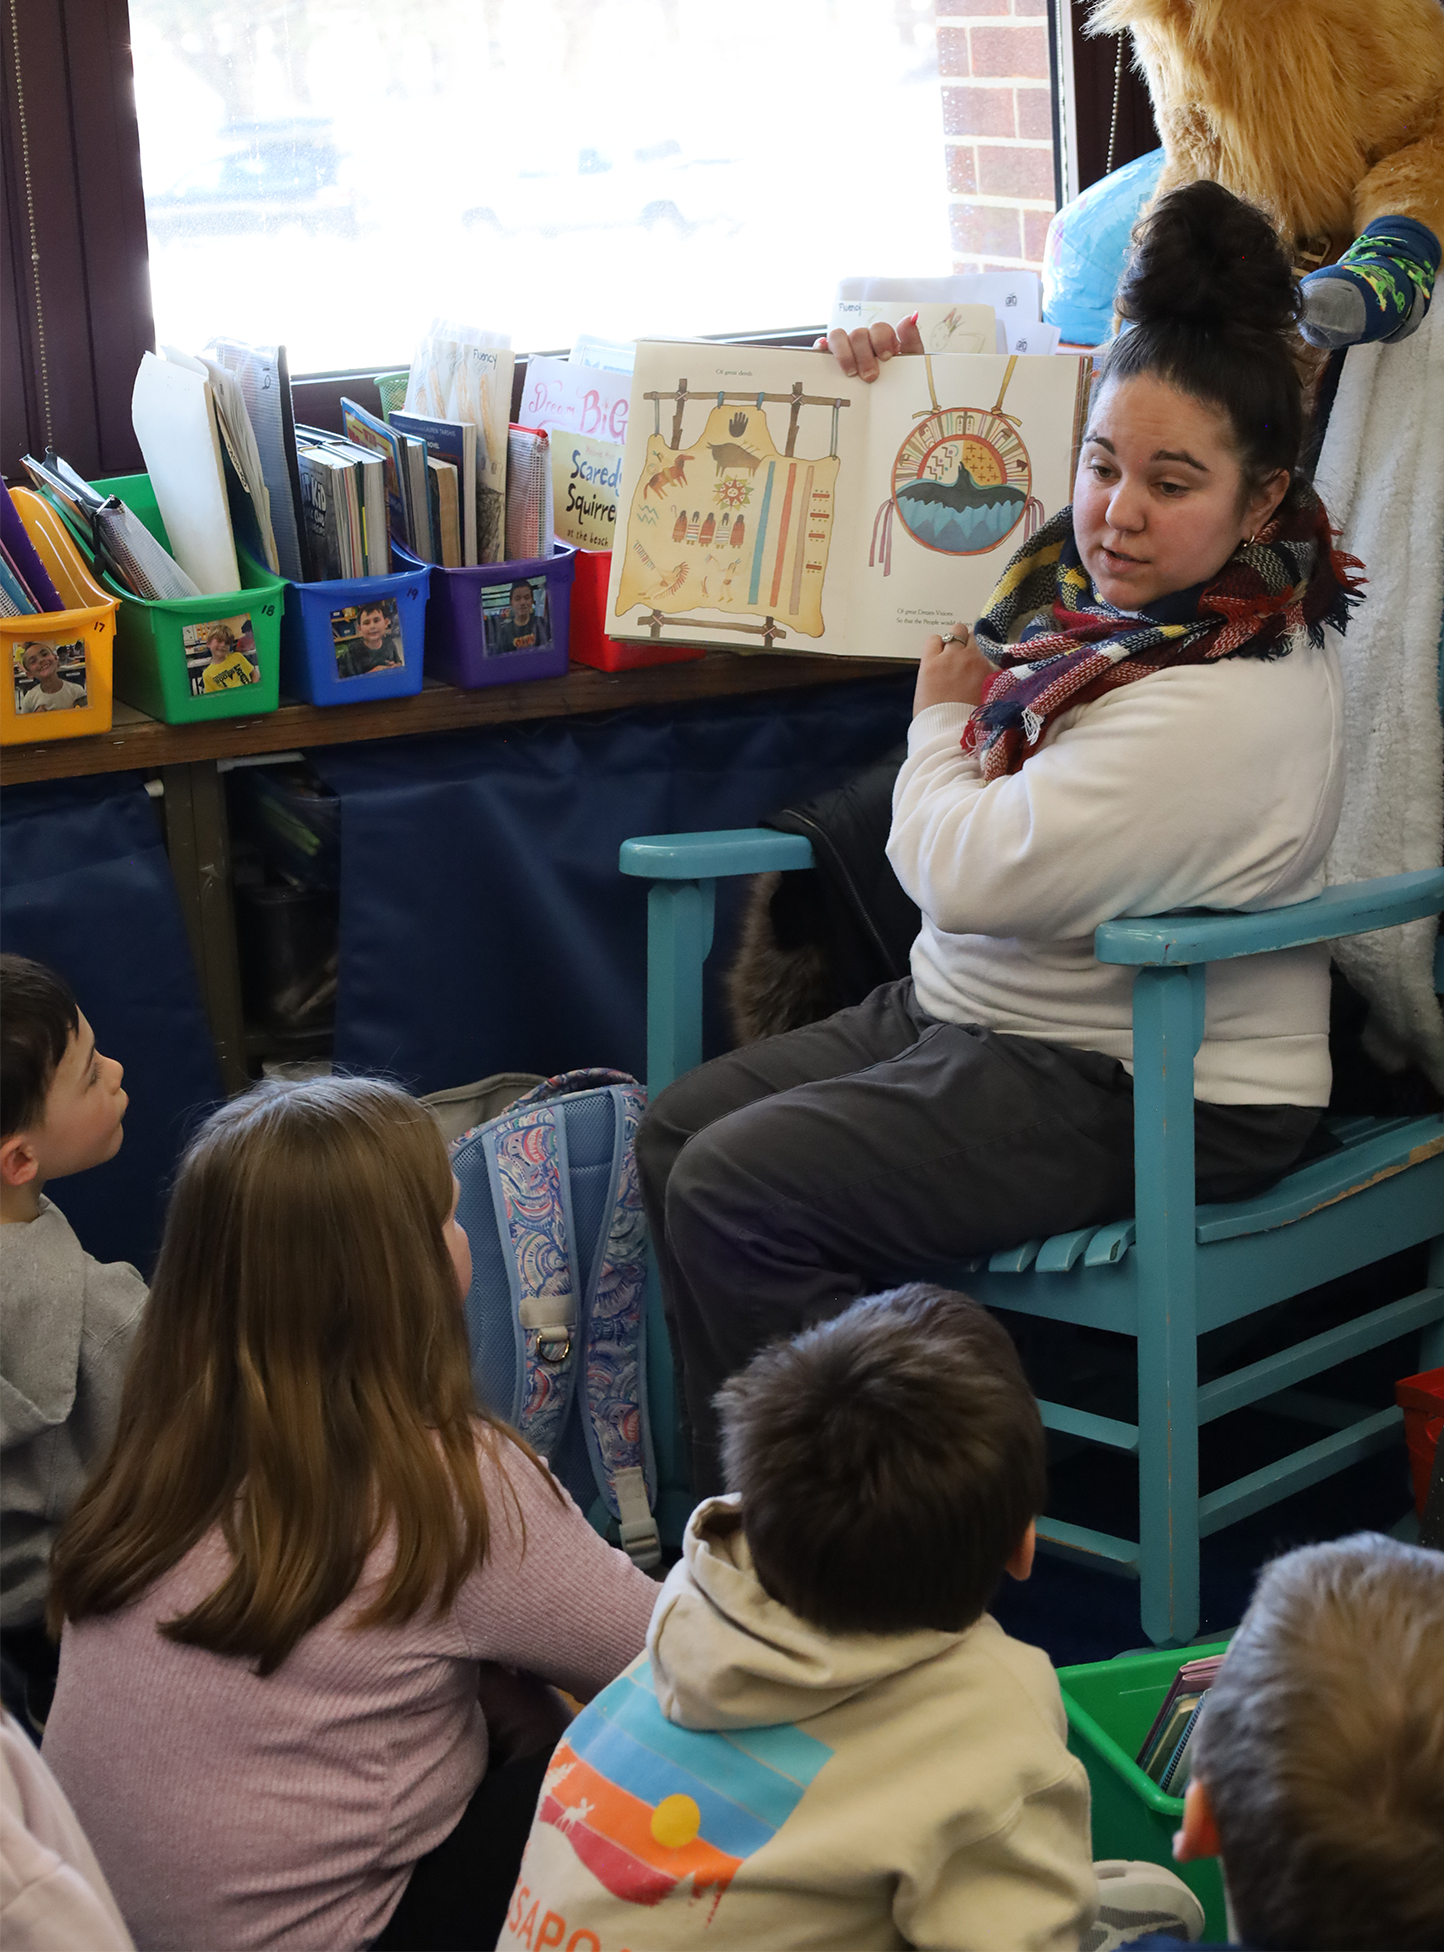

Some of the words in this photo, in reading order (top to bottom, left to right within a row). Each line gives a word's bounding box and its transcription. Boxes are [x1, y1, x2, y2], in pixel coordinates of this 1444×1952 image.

[838, 302, 862, 317] Fluency
[473, 348, 498, 370] Fluency
[529, 380, 575, 419] Dream
[566, 483, 617, 525] Squirre
[567, 529, 574, 538] at
[576, 530, 588, 542] the
[590, 532, 609, 548] beach
[406, 586, 419, 601] 19
[261, 604, 275, 617] 18
[94, 621, 106, 633] 17
[923, 618, 940, 626] People
[507, 1876, 633, 1952] SAPO
